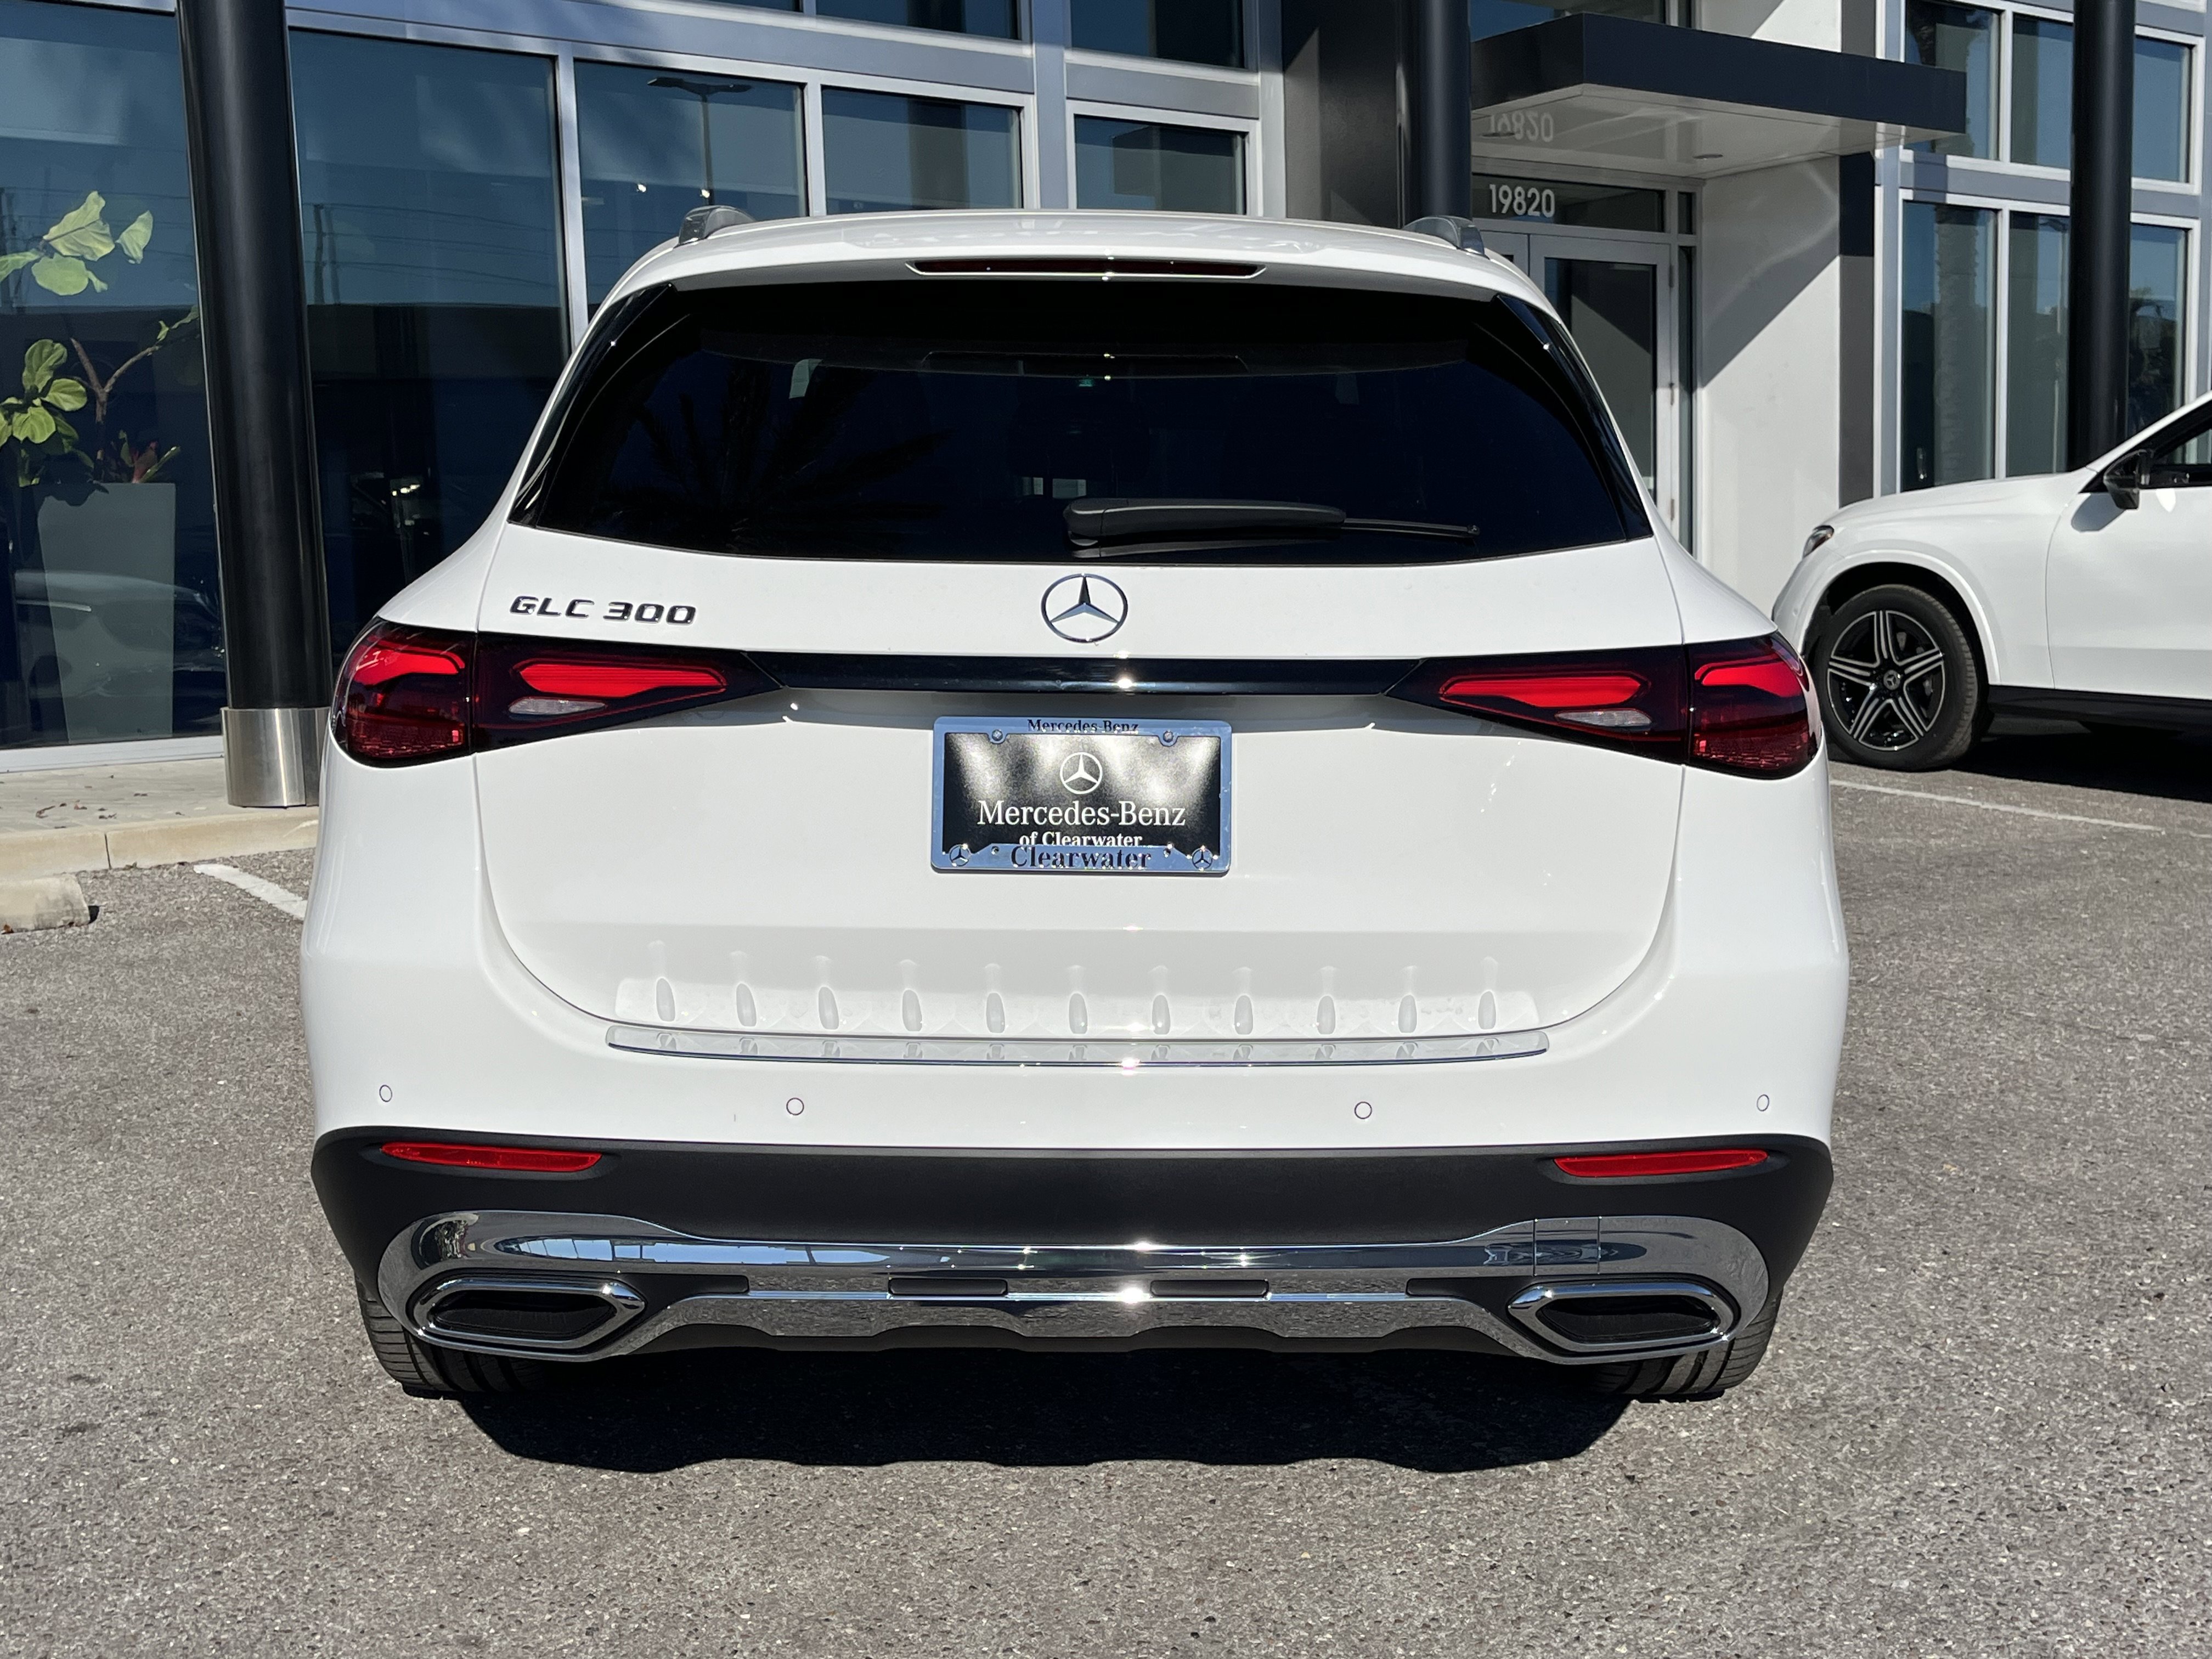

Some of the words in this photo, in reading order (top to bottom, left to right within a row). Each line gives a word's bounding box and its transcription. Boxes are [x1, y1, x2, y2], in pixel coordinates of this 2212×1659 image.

[1489, 184, 1555, 218] 19820
[509, 596, 595, 619] GLC
[602, 601, 696, 625] 300
[1028, 719, 1139, 733] Mercedes-Benz
[977, 799, 1186, 826] Mercedes-Benz
[1019, 831, 1038, 845] of
[1042, 831, 1143, 847] Clearwater
[1011, 845, 1152, 870] Clearwater
